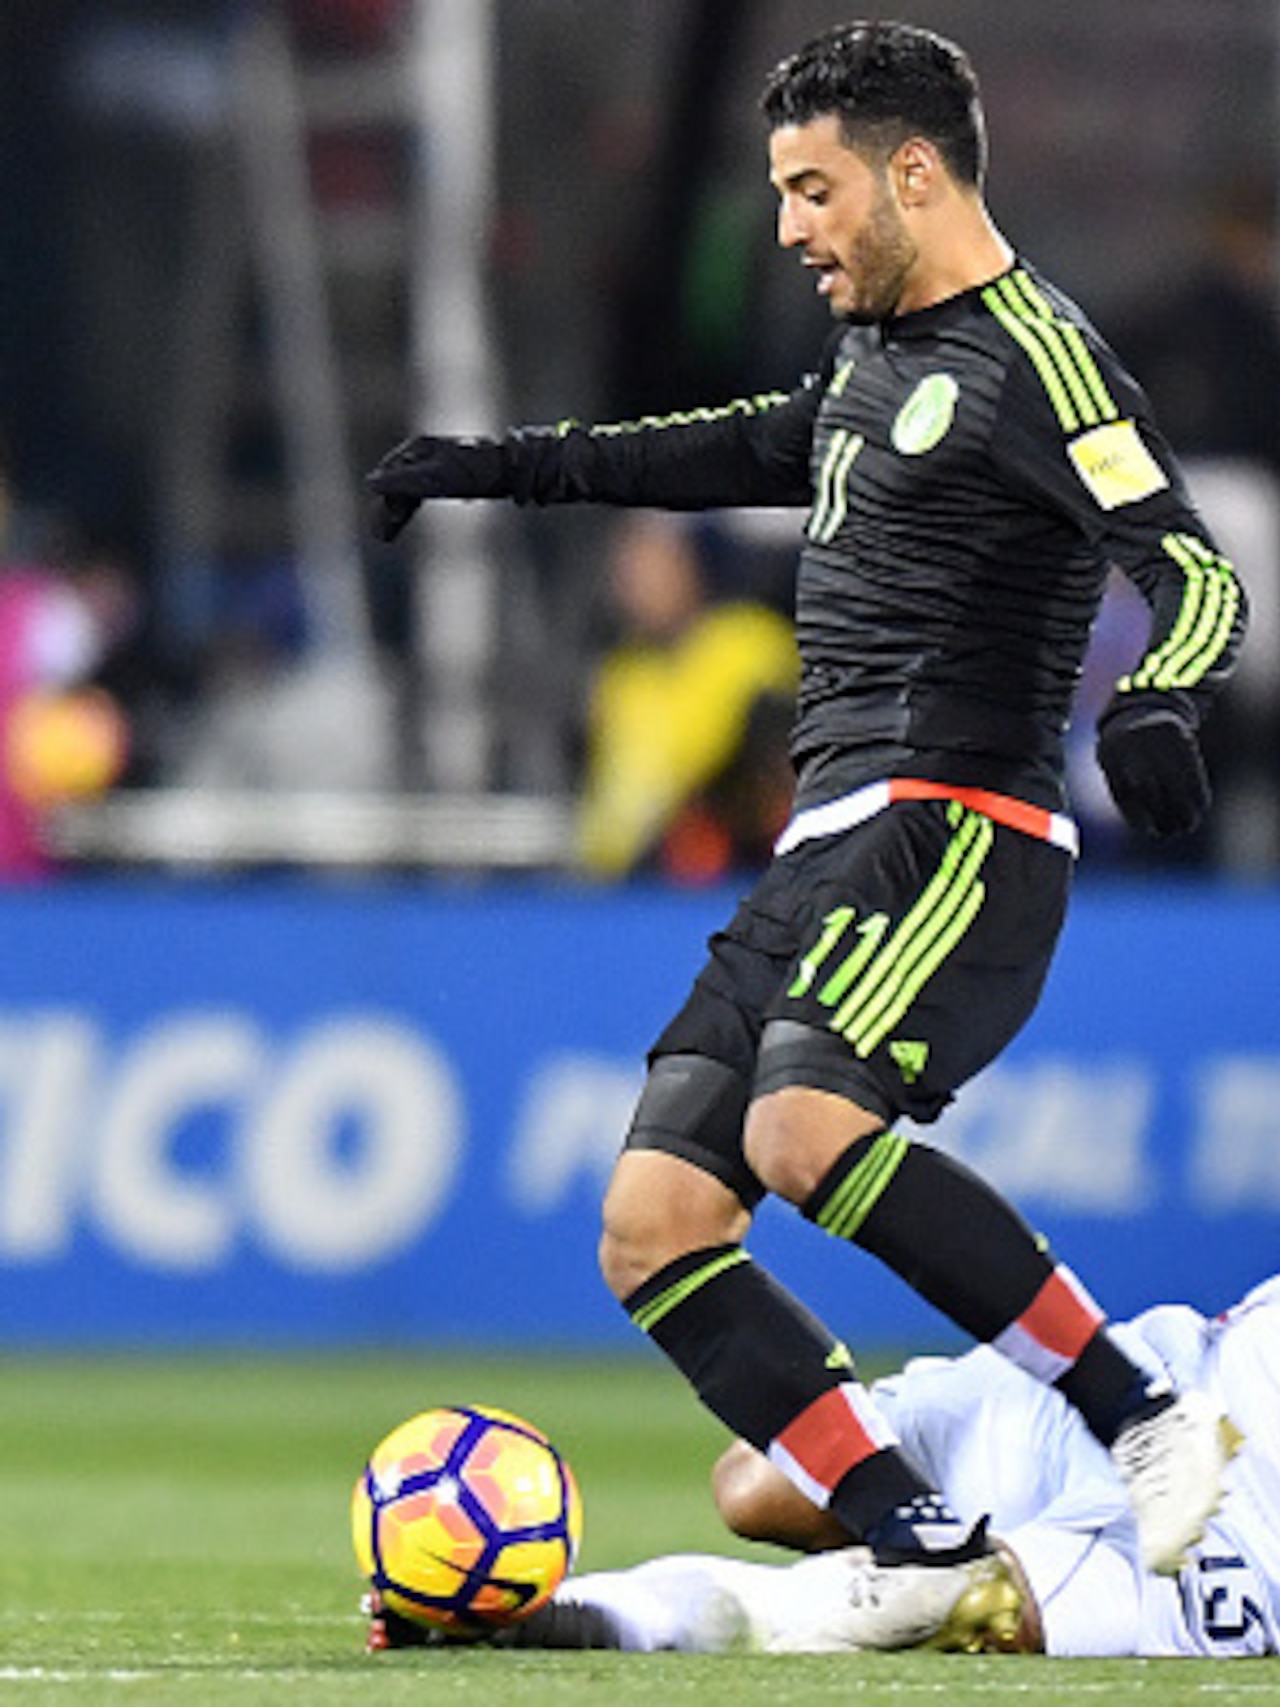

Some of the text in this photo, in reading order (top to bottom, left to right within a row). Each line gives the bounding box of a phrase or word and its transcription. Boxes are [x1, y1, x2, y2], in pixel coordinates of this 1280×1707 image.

[808, 428, 865, 542] 11
[787, 906, 890, 1007] 11
[0, 1008, 464, 1271] ICO
